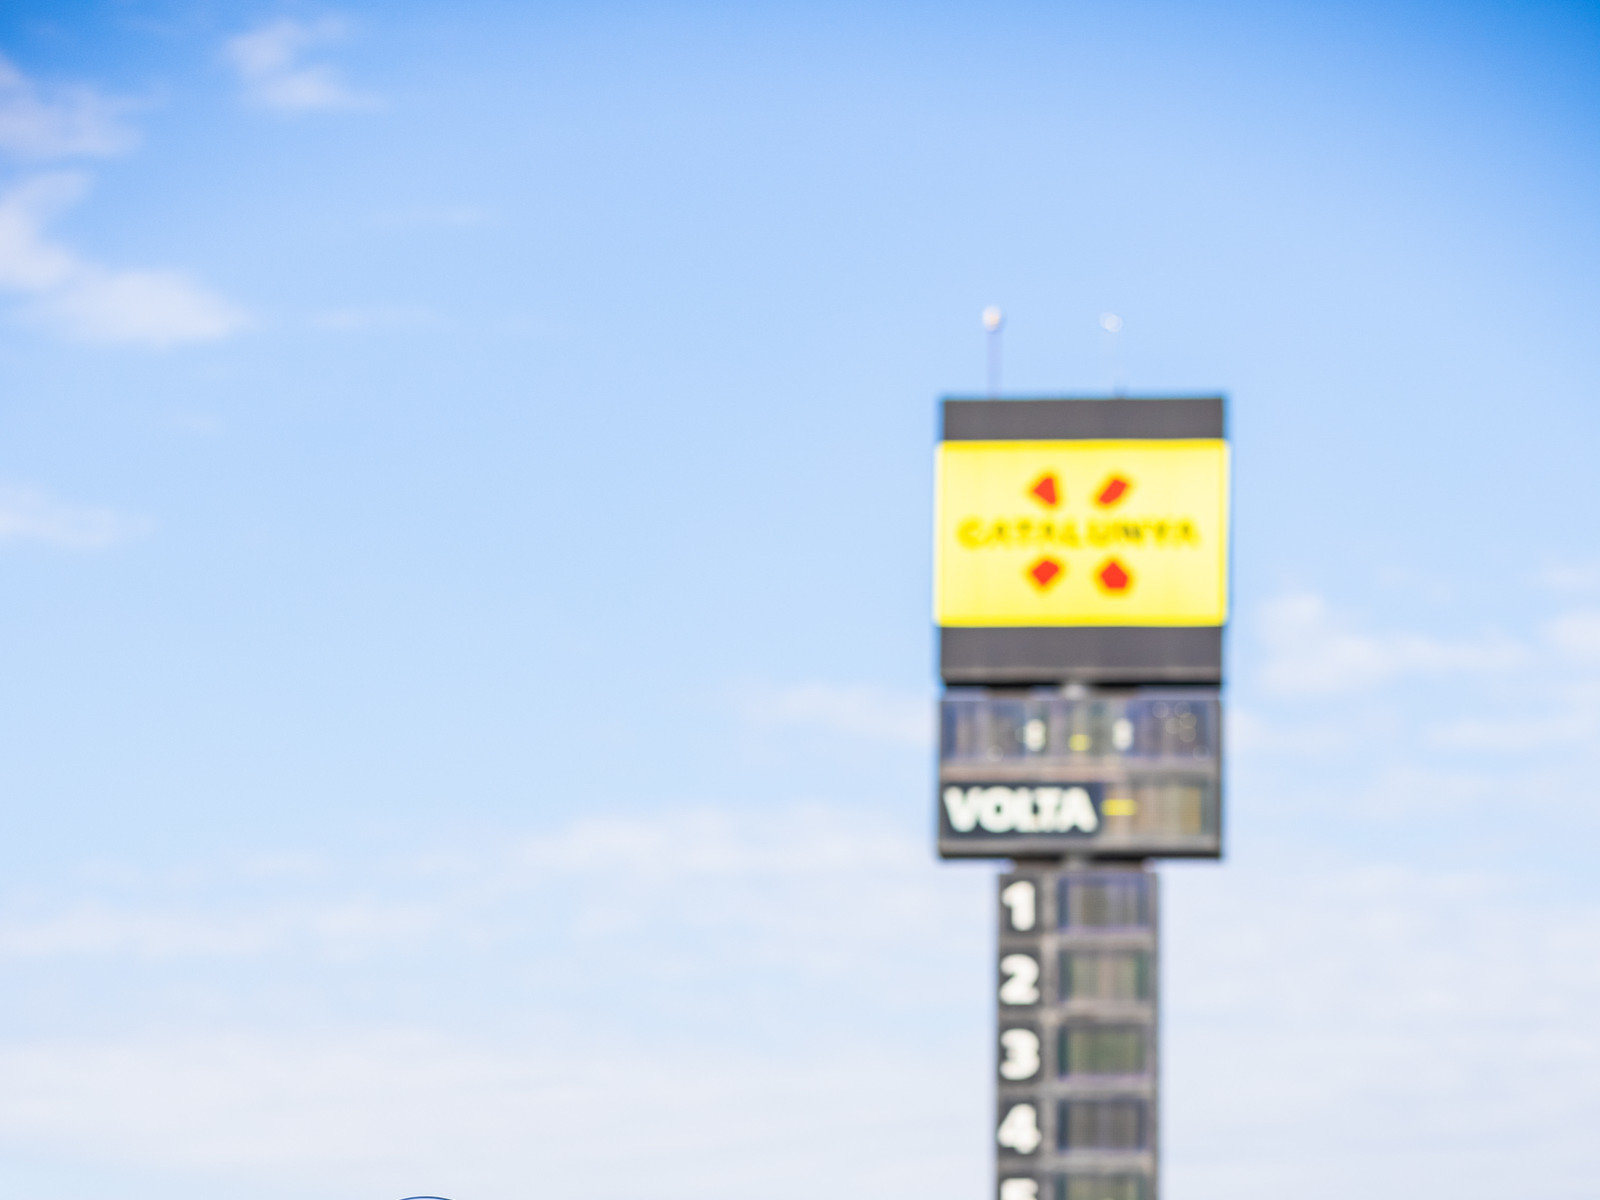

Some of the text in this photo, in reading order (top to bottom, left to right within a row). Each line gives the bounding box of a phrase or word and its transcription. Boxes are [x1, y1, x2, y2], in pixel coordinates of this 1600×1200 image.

[957, 518, 1200, 549] CATALUNYA
[944, 786, 1098, 833] VOLTA
[1002, 880, 1036, 932] 1
[1000, 953, 1040, 1005] 2
[1000, 1028, 1040, 1081] 3
[997, 1103, 1041, 1154] 4
